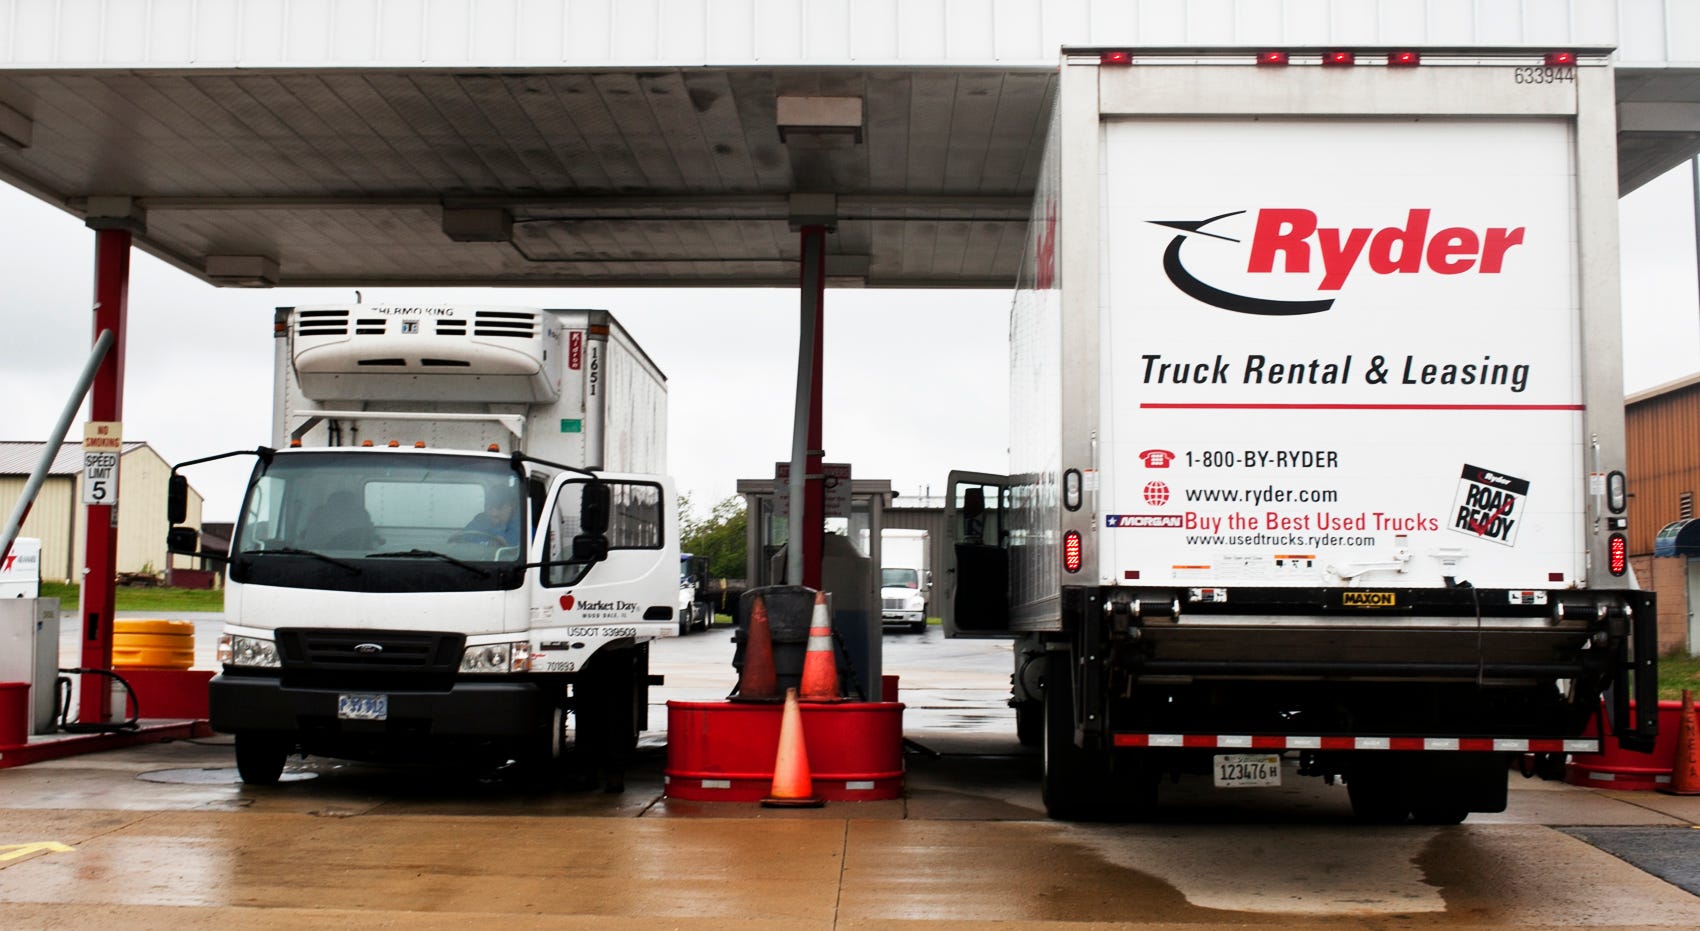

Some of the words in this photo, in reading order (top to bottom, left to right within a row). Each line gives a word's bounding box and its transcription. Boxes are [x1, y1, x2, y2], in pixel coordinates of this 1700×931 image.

[1514, 66, 1575, 84] 633944
[1246, 207, 1526, 291] Ryder
[590, 347, 599, 396] 1651
[1140, 354, 1230, 385] Truck
[1242, 354, 1350, 386] Rental
[1364, 355, 1389, 385] &
[1401, 355, 1531, 392] Leasing
[97, 425, 109, 435] NO
[86, 437, 120, 448] SMOKING
[85, 455, 116, 467] SPEED
[1185, 450, 1338, 468] 1-800-BY-RYDER
[88, 468, 112, 479] LIMIT
[1484, 472, 1512, 485] Ryder
[92, 481, 106, 500] 5
[1185, 485, 1338, 506] www.ryder.com
[1465, 483, 1515, 516] ROAD
[1119, 516, 1182, 527] MORGAN
[1185, 511, 1222, 534] Buy
[1228, 512, 1259, 530] the
[1266, 511, 1310, 530] Best
[1317, 512, 1366, 531] Used
[1372, 512, 1439, 531] Trucks
[1455, 505, 1516, 541] READY
[1186, 532, 1375, 549] www.usedtrucks.ryder.com
[577, 600, 612, 611] Market
[1344, 593, 1392, 605] MAXON
[567, 627, 599, 637] USDOT
[1220, 763, 1267, 780] 123476
